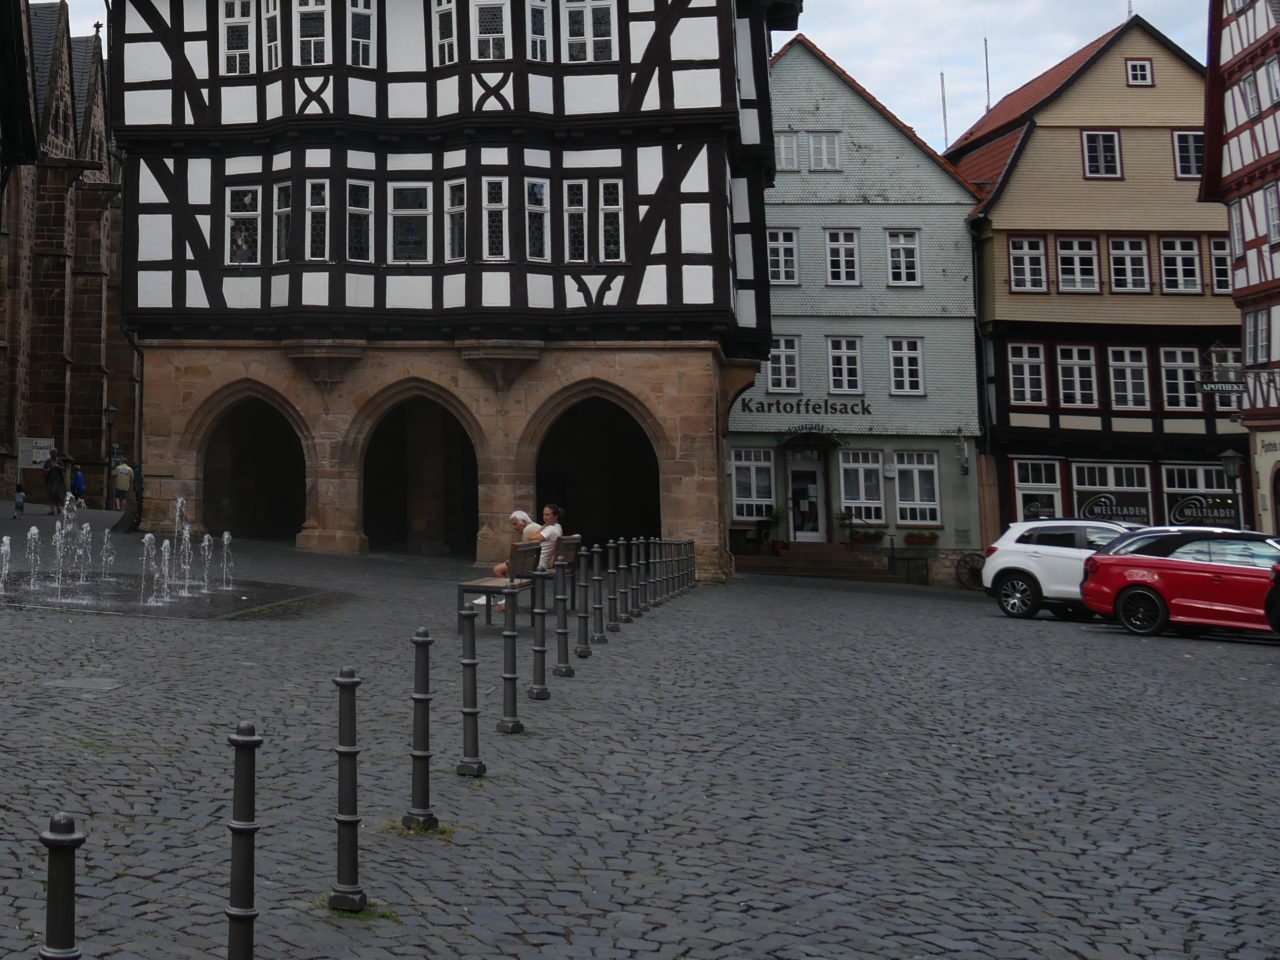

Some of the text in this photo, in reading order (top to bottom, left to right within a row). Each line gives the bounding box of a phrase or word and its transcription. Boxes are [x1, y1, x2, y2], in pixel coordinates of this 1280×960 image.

[1202, 383, 1246, 391] APOTHEKE
[741, 398, 872, 415] Kartoffelsack
[1093, 506, 1147, 516] WELTLADEN
